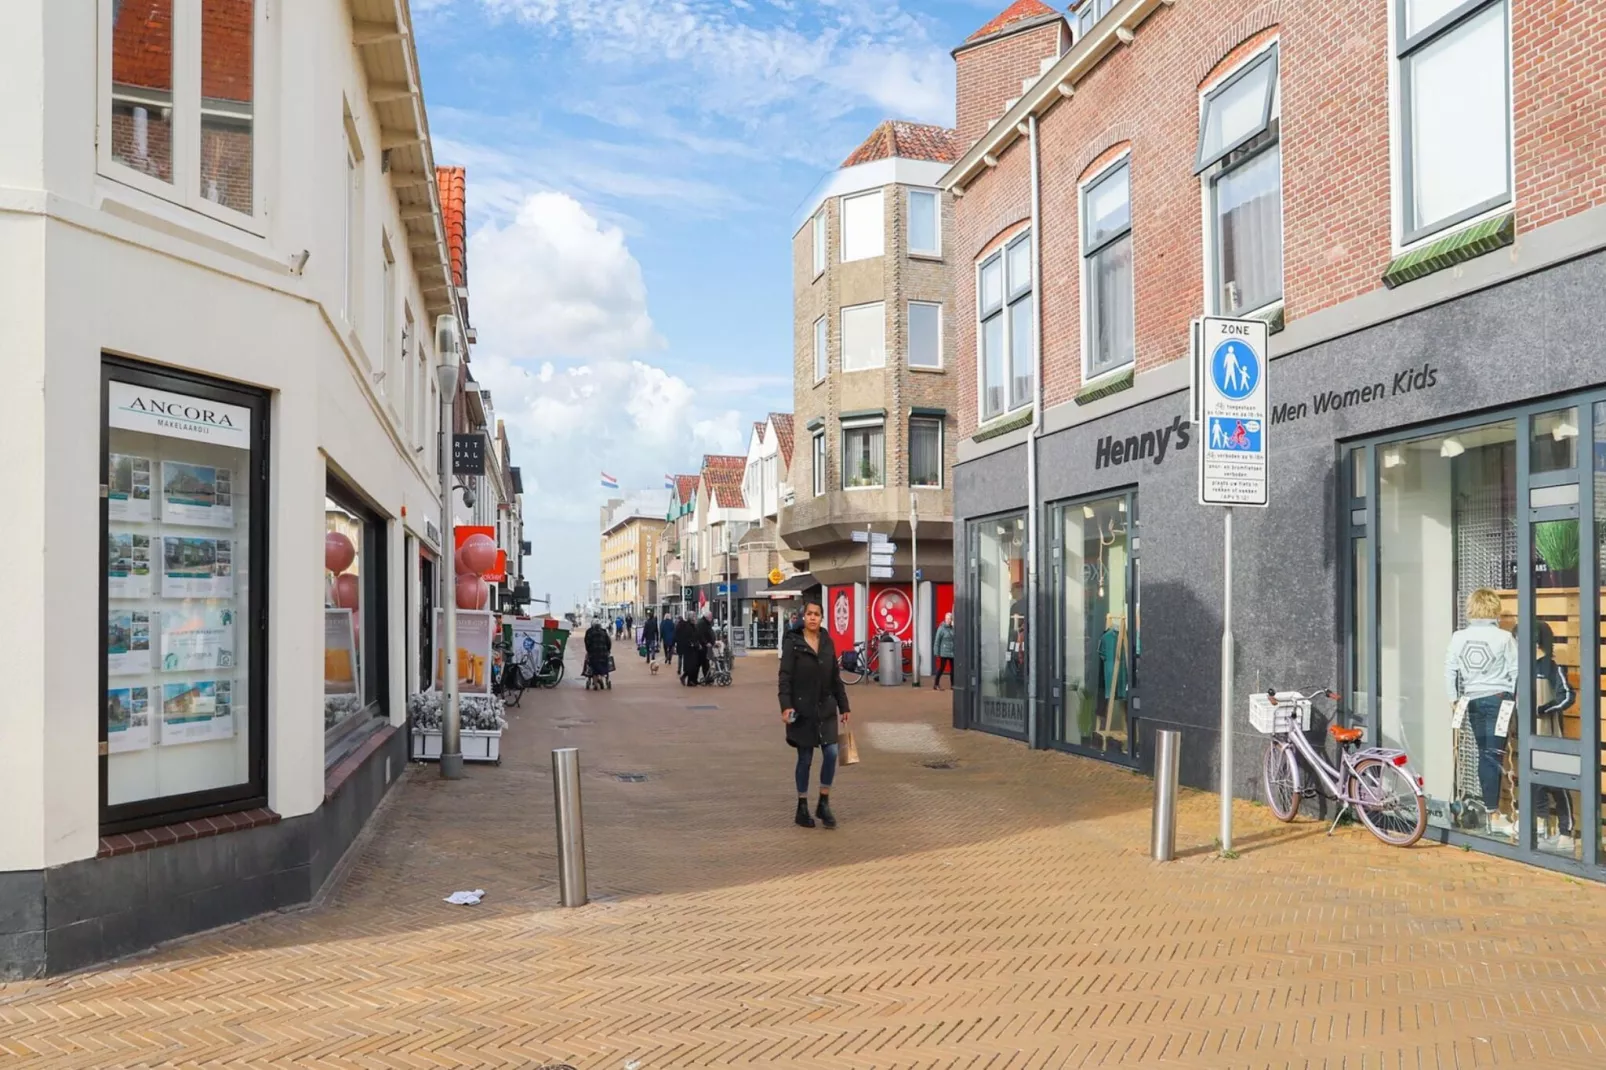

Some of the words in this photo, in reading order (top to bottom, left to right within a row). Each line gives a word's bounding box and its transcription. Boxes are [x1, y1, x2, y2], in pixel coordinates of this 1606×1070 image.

[1221, 324, 1250, 335] ZONE
[1271, 403, 1307, 425] Men
[1314, 383, 1385, 415] Women
[1392, 364, 1438, 396] Kids
[130, 397, 233, 427] ANCORA
[157, 419, 210, 434] MAKELAARDIJ
[1096, 415, 1190, 470] Henny's
